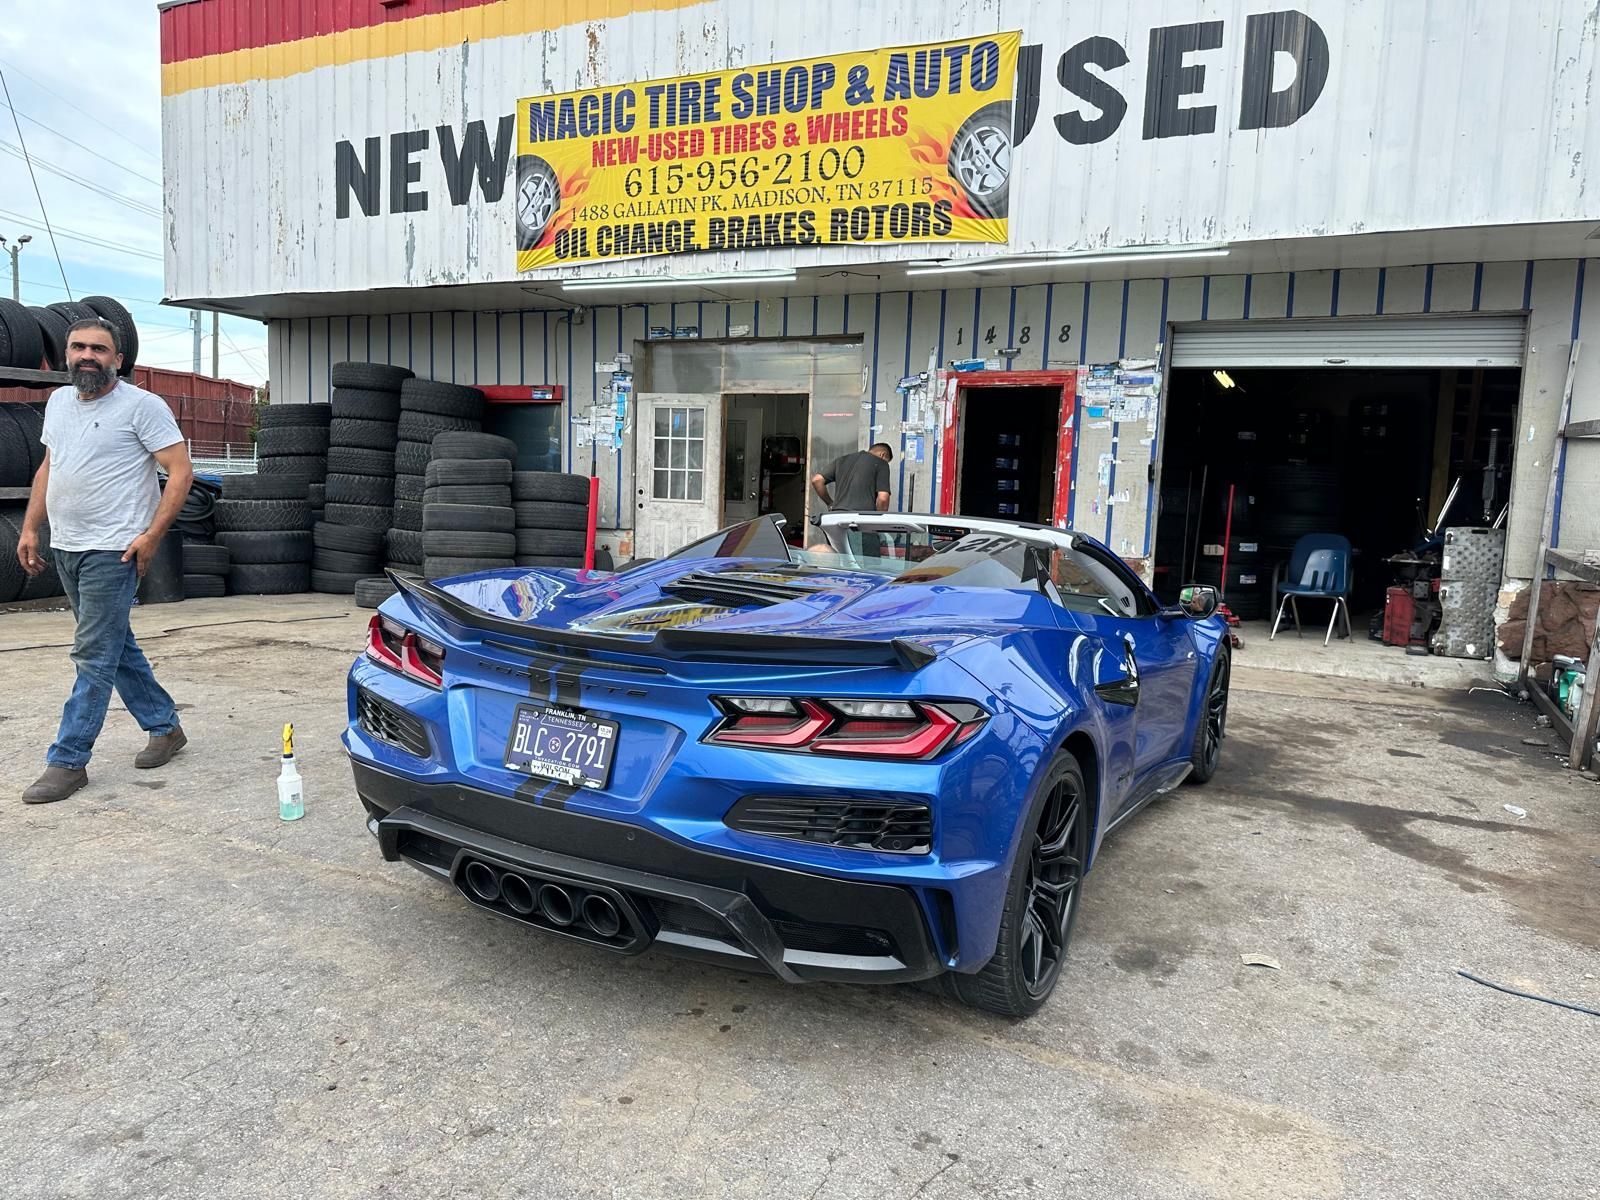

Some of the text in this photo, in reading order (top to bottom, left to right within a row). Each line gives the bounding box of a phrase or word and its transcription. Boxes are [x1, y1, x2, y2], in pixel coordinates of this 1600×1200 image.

[529, 40, 1001, 144] MAGIC TIRE SHOP & AUTO
[591, 105, 908, 168] NEW-USED TIRES & WHEELS
[335, 113, 516, 219] NEW
[624, 145, 866, 198] 615-956-2100
[571, 176, 933, 223] 1488 GALLATIN PK. MADISON, TN 37115
[554, 227, 591, 260] OIL
[830, 199, 953, 242] ROTORS
[479, 661, 649, 698] CORVETTE
[545, 707, 576, 721] FRANKLIN,
[578, 714, 587, 722] TN
[548, 716, 584, 728] TENNESSEE
[513, 723, 607, 769] BLC 2791
